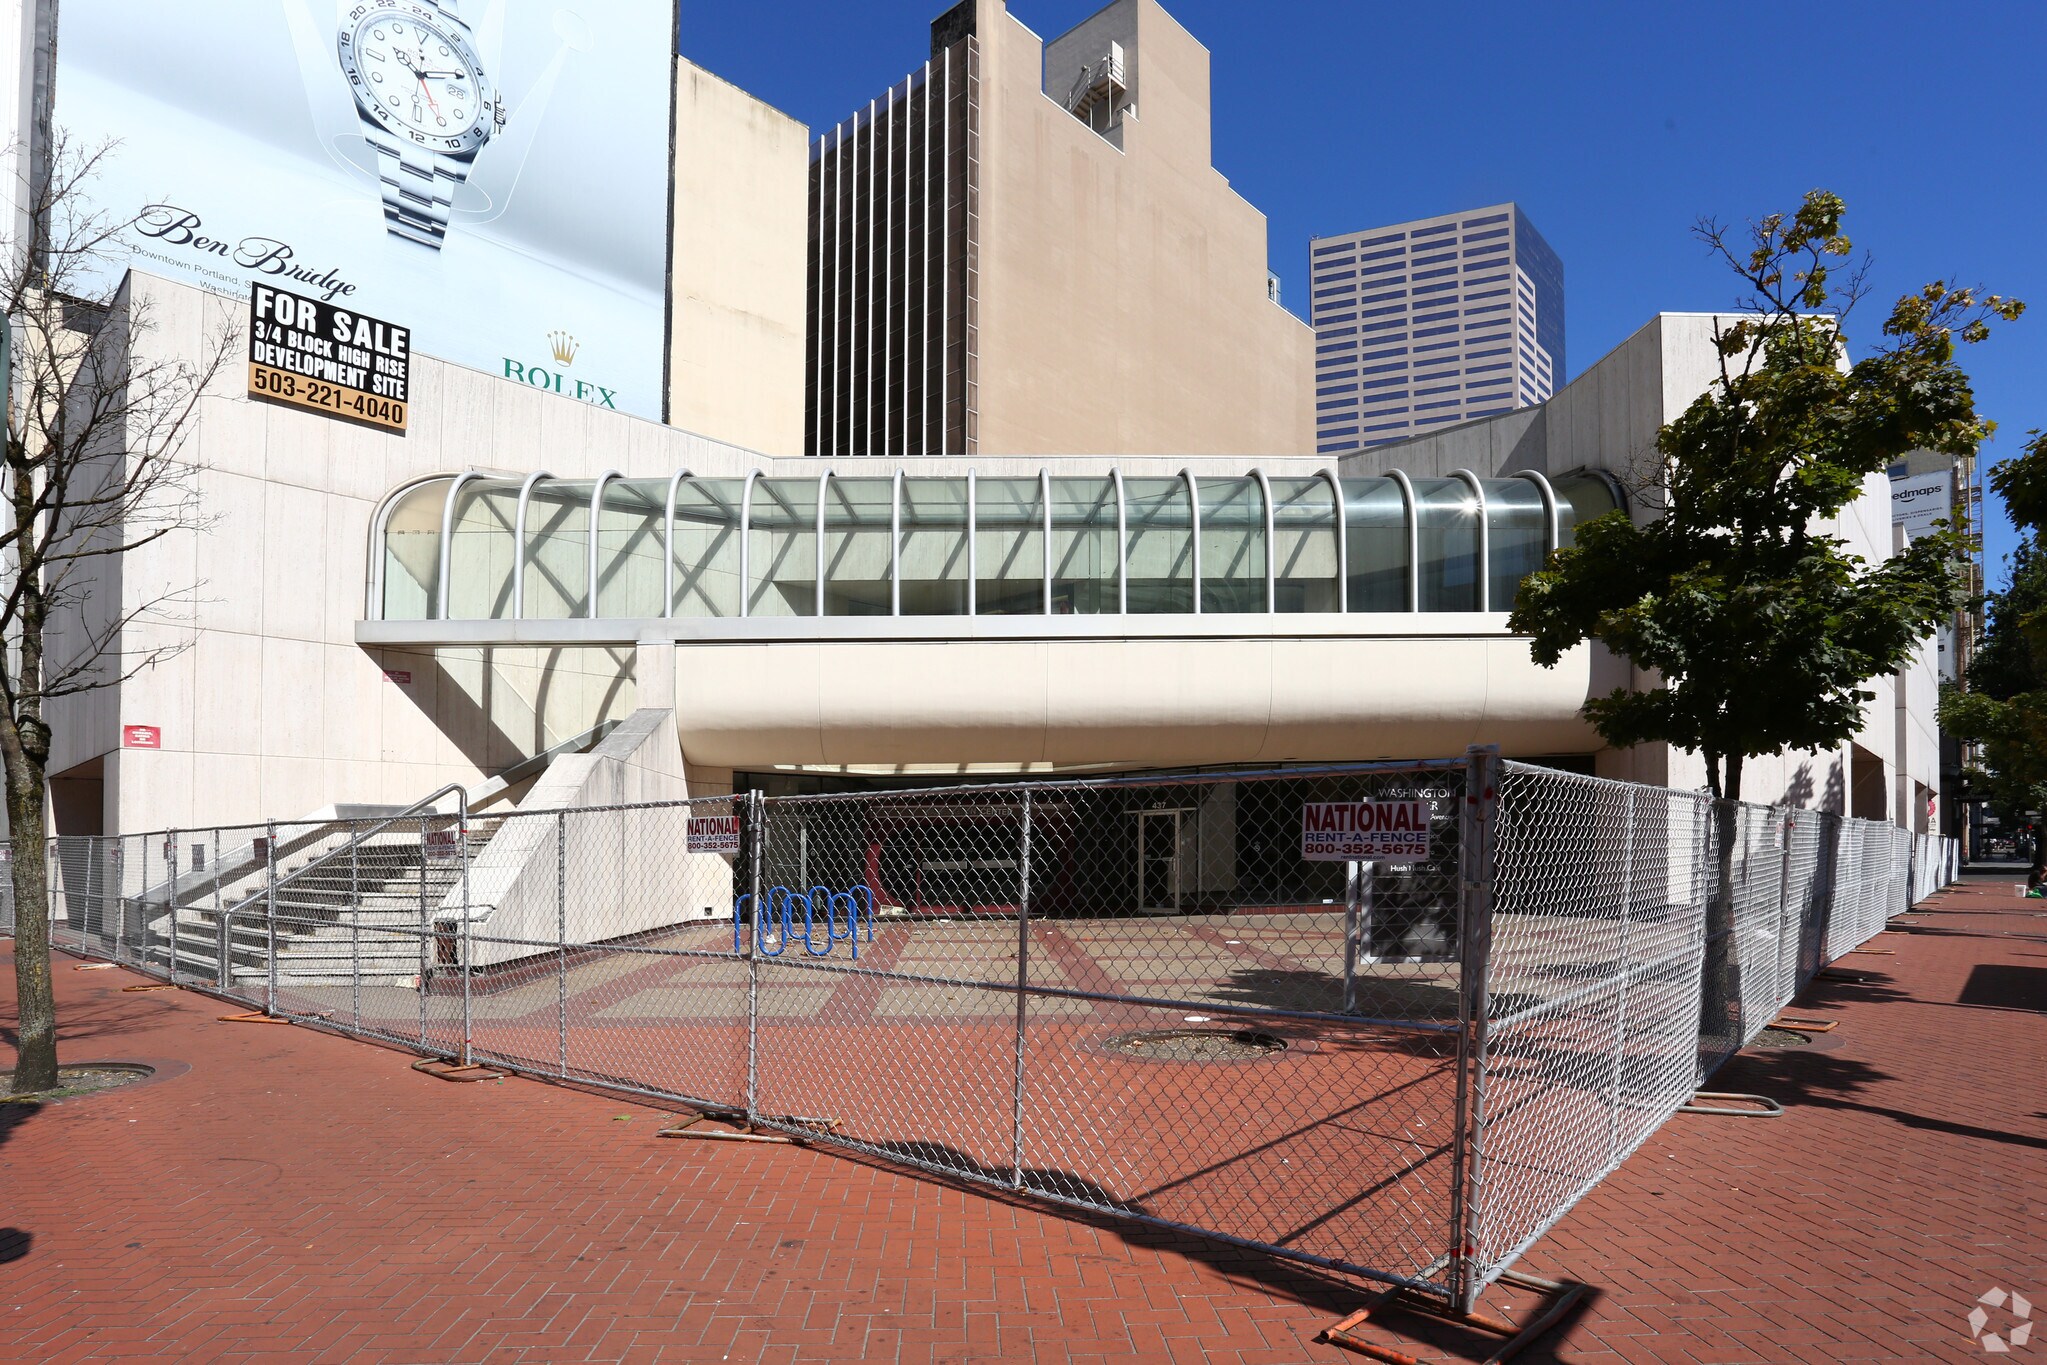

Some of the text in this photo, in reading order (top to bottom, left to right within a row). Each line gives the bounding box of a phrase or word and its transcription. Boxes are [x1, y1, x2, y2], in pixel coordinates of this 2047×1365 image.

[349, 5, 367, 20] 20
[412, 6, 433, 21] 24
[341, 32, 350, 47] 18
[348, 68, 361, 85] 16
[475, 67, 484, 76] 4
[448, 86, 464, 99] 28
[373, 104, 389, 121] 14
[408, 131, 425, 144] 12
[473, 127, 483, 137] 8
[445, 138, 461, 148] 10
[134, 204, 357, 301] Ben Bridge
[132, 245, 191, 271] Downtown
[194, 264, 241, 287] Portland,
[256, 286, 406, 360] FOR SALE
[255, 320, 406, 379] 3/4 BLOCK HIGH RISE
[254, 340, 405, 400] DEVELOPMENT SITE
[502, 357, 617, 410] ROLEX
[254, 368, 404, 424] 503-221-4040
[1892, 485, 1942, 500] edmaps
[1378, 788, 1457, 798] WASHINGTON
[1152, 801, 1167, 809] 437
[1305, 803, 1427, 832] NATIONAL
[687, 817, 738, 835] NATIONAL
[1305, 832, 1427, 842] RENT-A-FENCE
[1304, 843, 1426, 855] 800-352-5675
[1390, 864, 1407, 872] Hush
